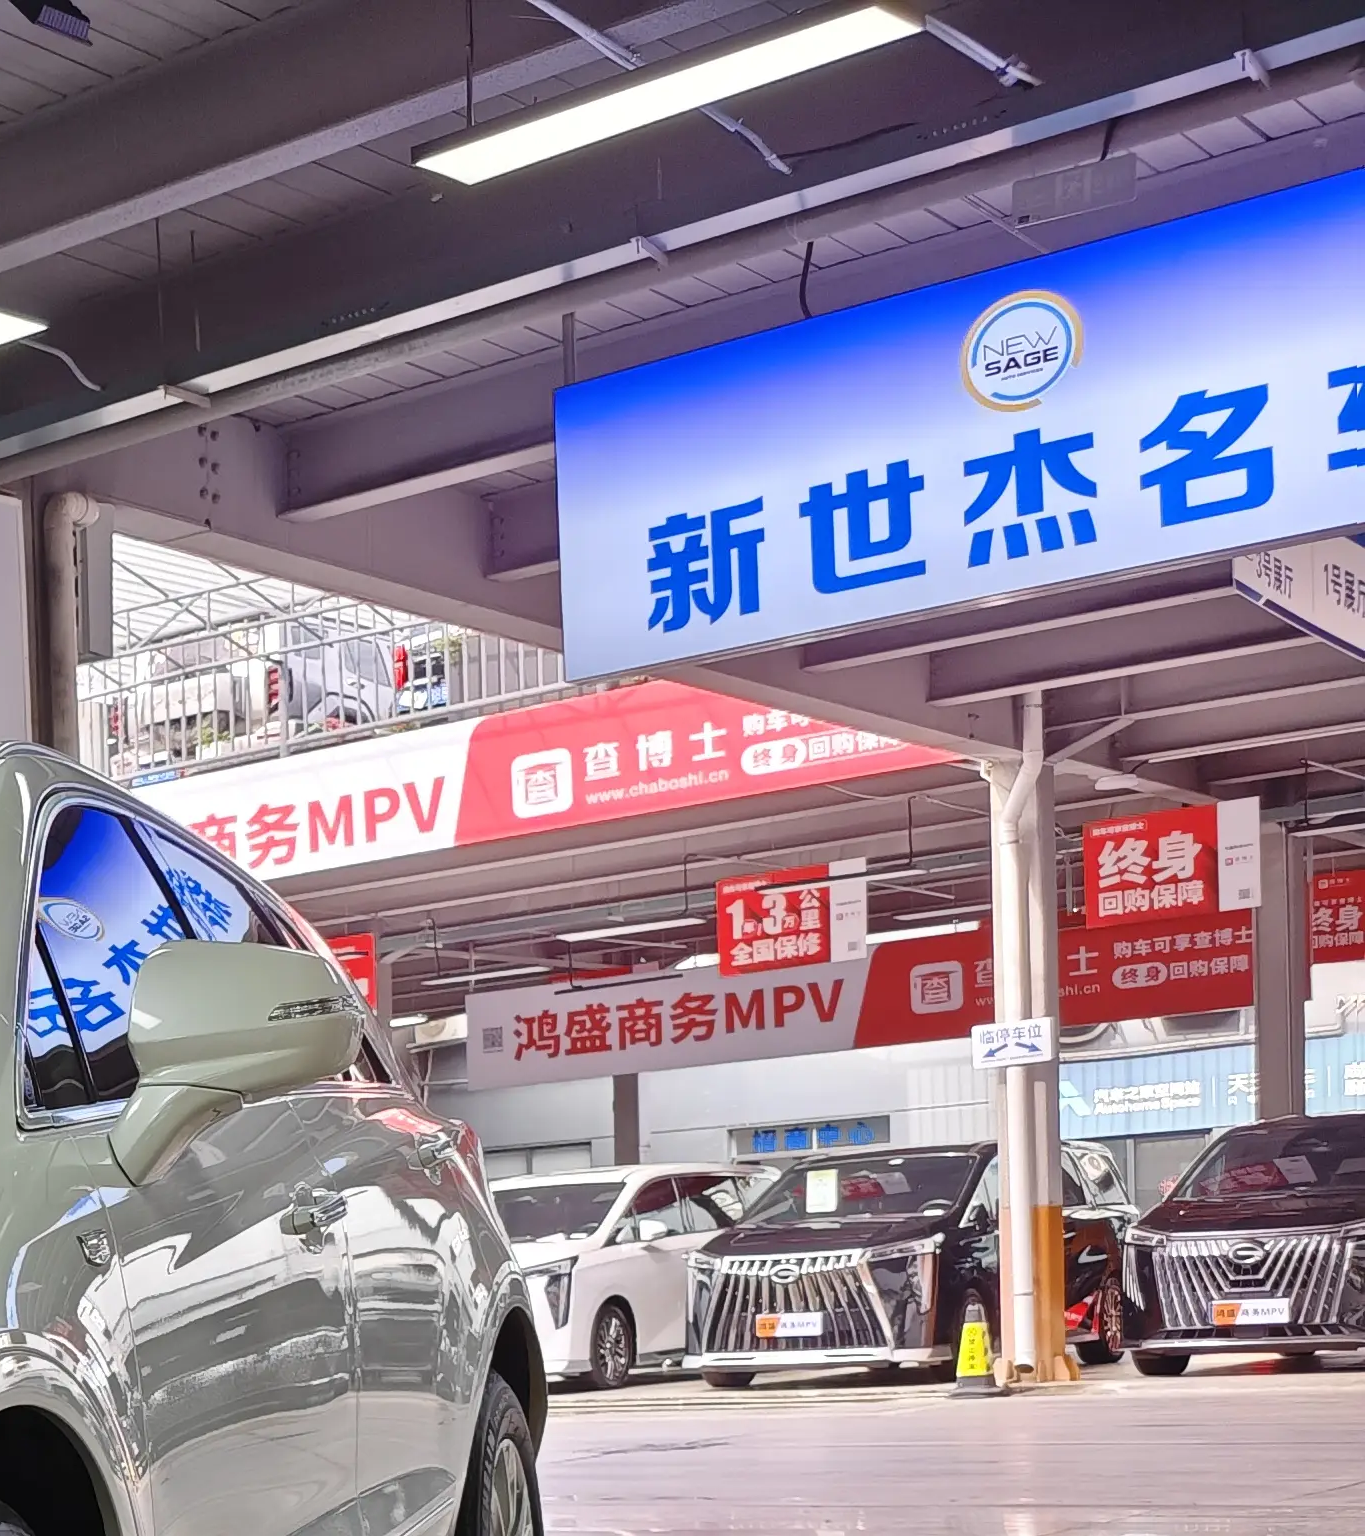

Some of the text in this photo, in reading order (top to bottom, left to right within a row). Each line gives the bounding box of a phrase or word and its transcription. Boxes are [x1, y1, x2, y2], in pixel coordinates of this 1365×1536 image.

[982, 325, 1058, 361] NEW
[984, 345, 1059, 378] SAGE
[585, 768, 730, 805] www.chaboshi.cn
[1097, 830, 1203, 889] 终身
[1097, 880, 1205, 918] 回购保障
[729, 931, 821, 967] 全国保修
[1113, 925, 1254, 960] 购车可享查博士
[512, 978, 845, 1062] 鸿盛商务MPV
[979, 1023, 1043, 1045] 临停车位
